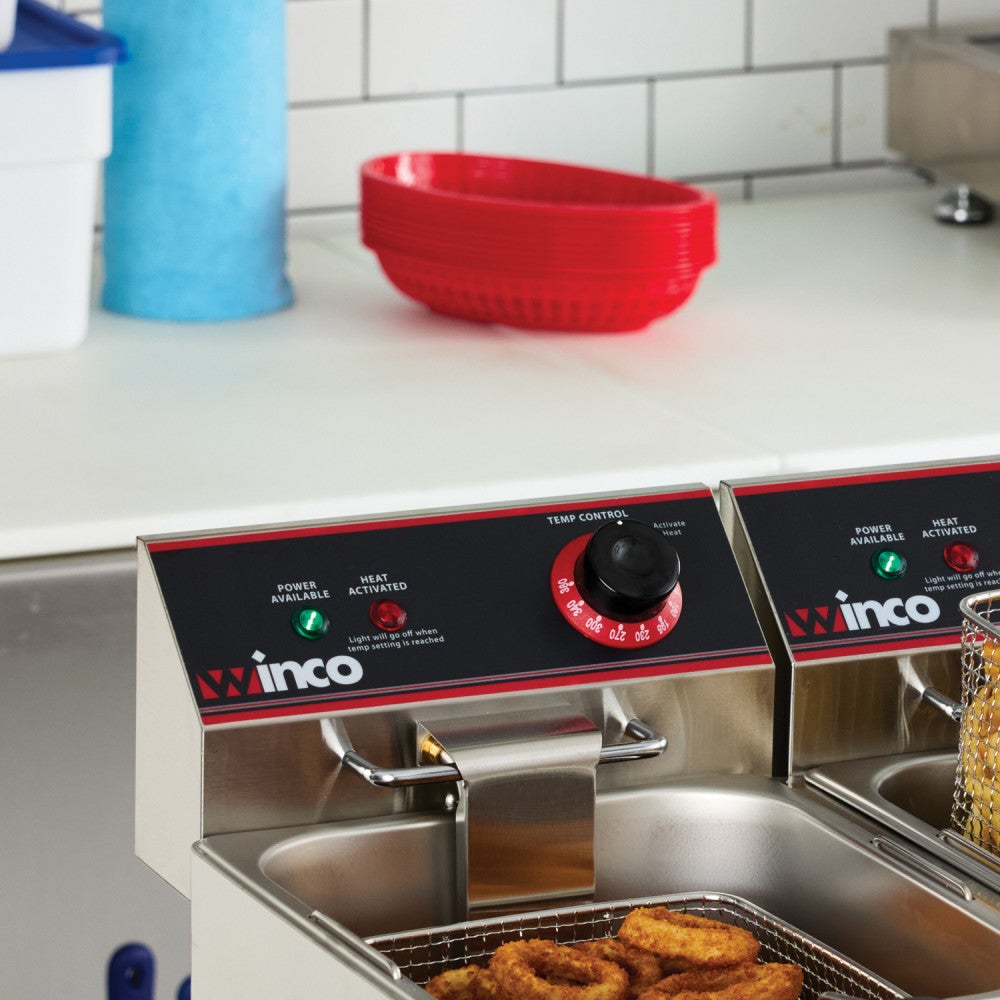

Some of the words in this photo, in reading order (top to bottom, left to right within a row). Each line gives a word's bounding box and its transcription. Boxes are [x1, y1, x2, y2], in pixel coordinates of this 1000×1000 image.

[547, 514, 576, 525] TEMP
[578, 509, 629, 522] CONTROL
[932, 517, 958, 528] HEAT
[653, 520, 686, 530] Activate
[855, 524, 893, 536] POWER
[922, 525, 978, 539] ACTIVATED
[662, 529, 682, 537] Heat
[850, 532, 906, 546] AVAILABLE
[360, 573, 388, 584] HEAT
[924, 575, 945, 586] Light
[947, 573, 961, 582] will
[963, 573, 973, 582] go
[974, 570, 985, 579] off
[277, 581, 317, 593] POWER
[348, 581, 408, 596] ACTIVATED
[924, 584, 945, 593] temp
[946, 580, 975, 591] setting
[976, 578, 983, 587] is
[271, 589, 330, 604] AVAILABLE
[567, 600, 583, 617] 340
[585, 617, 603, 633] 300
[348, 635, 371, 646] Light
[372, 632, 387, 641] will
[389, 632, 400, 641] go
[401, 629, 413, 638] off
[415, 627, 438, 637] when
[609, 629, 627, 642] 270
[635, 629, 650, 642] 230
[347, 644, 370, 653] temp
[371, 640, 401, 650] setting
[402, 638, 410, 647] is
[411, 635, 445, 645] reached
